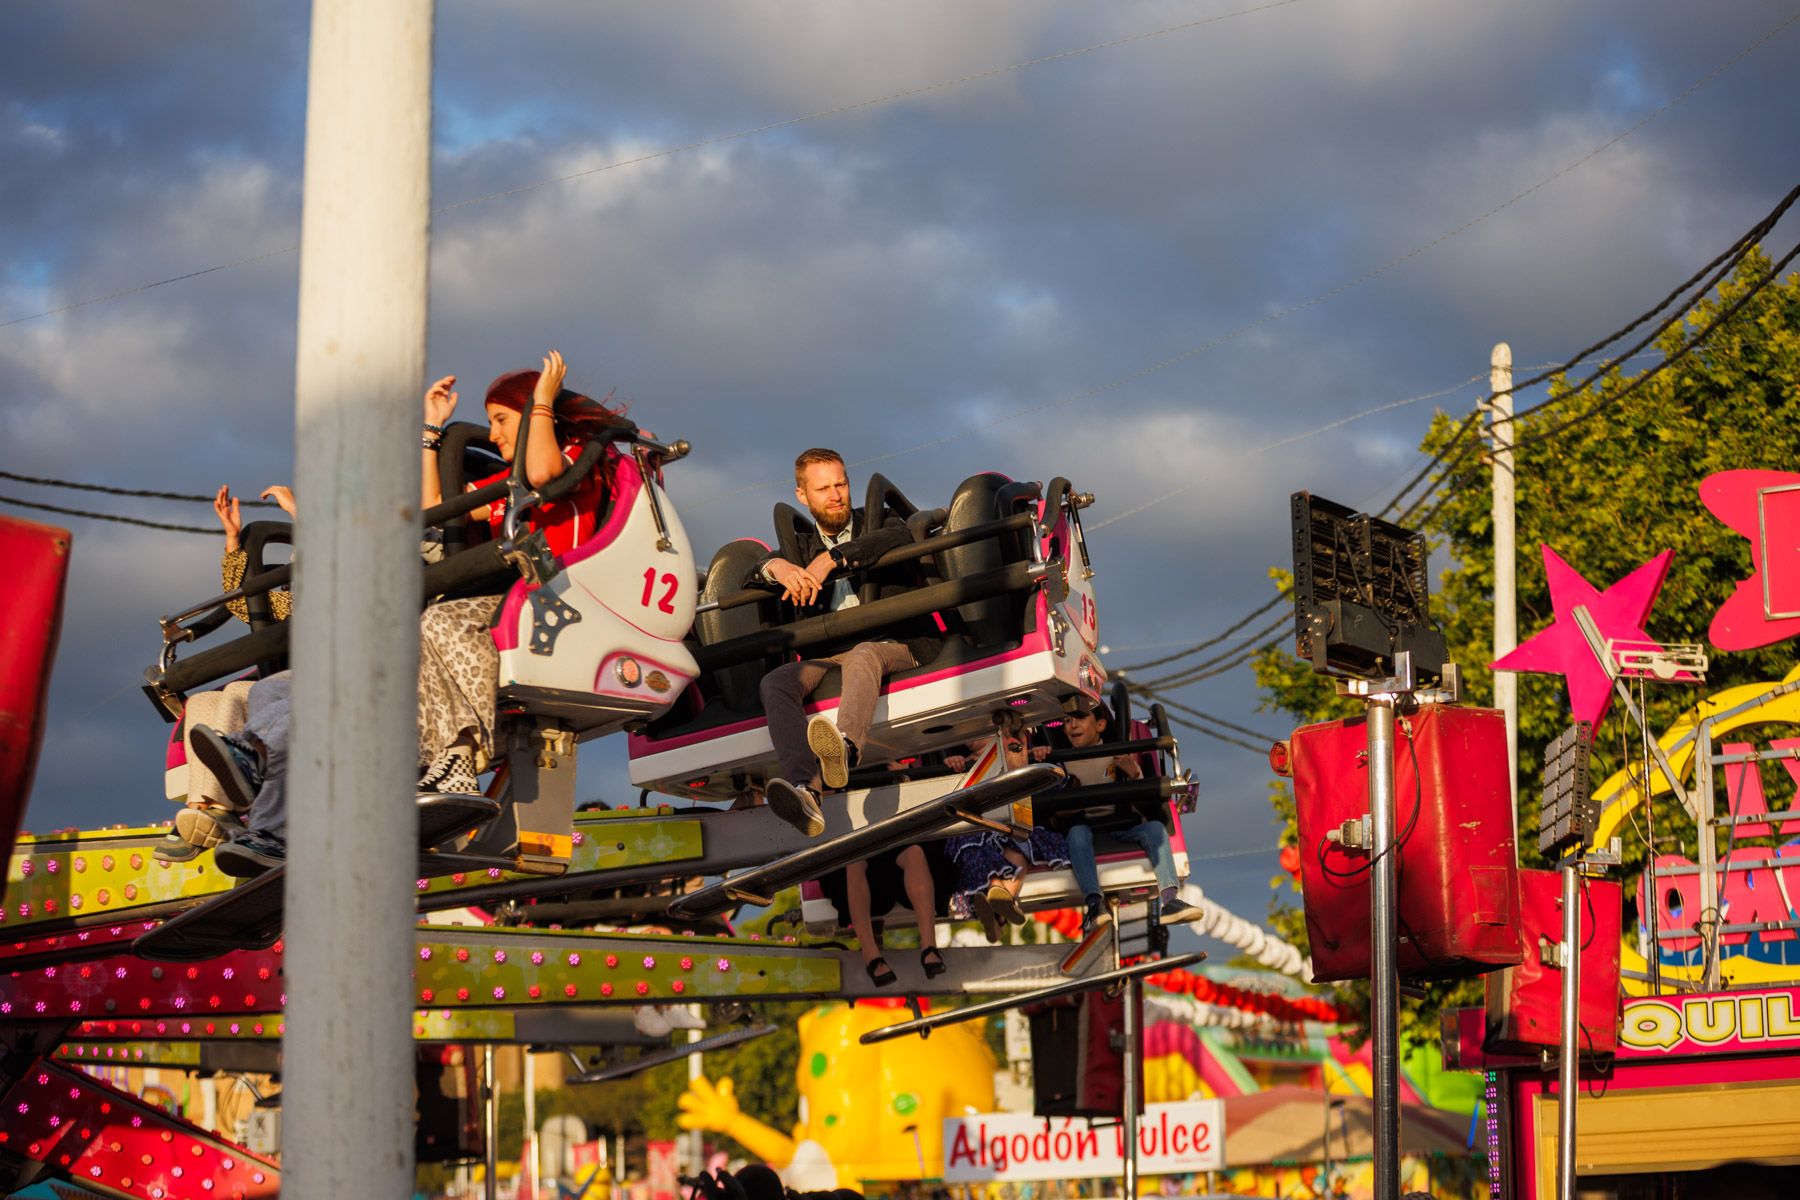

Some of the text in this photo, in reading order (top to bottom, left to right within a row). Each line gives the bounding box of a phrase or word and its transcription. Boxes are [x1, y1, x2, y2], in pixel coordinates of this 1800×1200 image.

[641, 567, 679, 615] 12
[1082, 592, 1096, 631] 13
[1618, 995, 1800, 1049] QUIL
[949, 1117, 1098, 1172] Algodón
